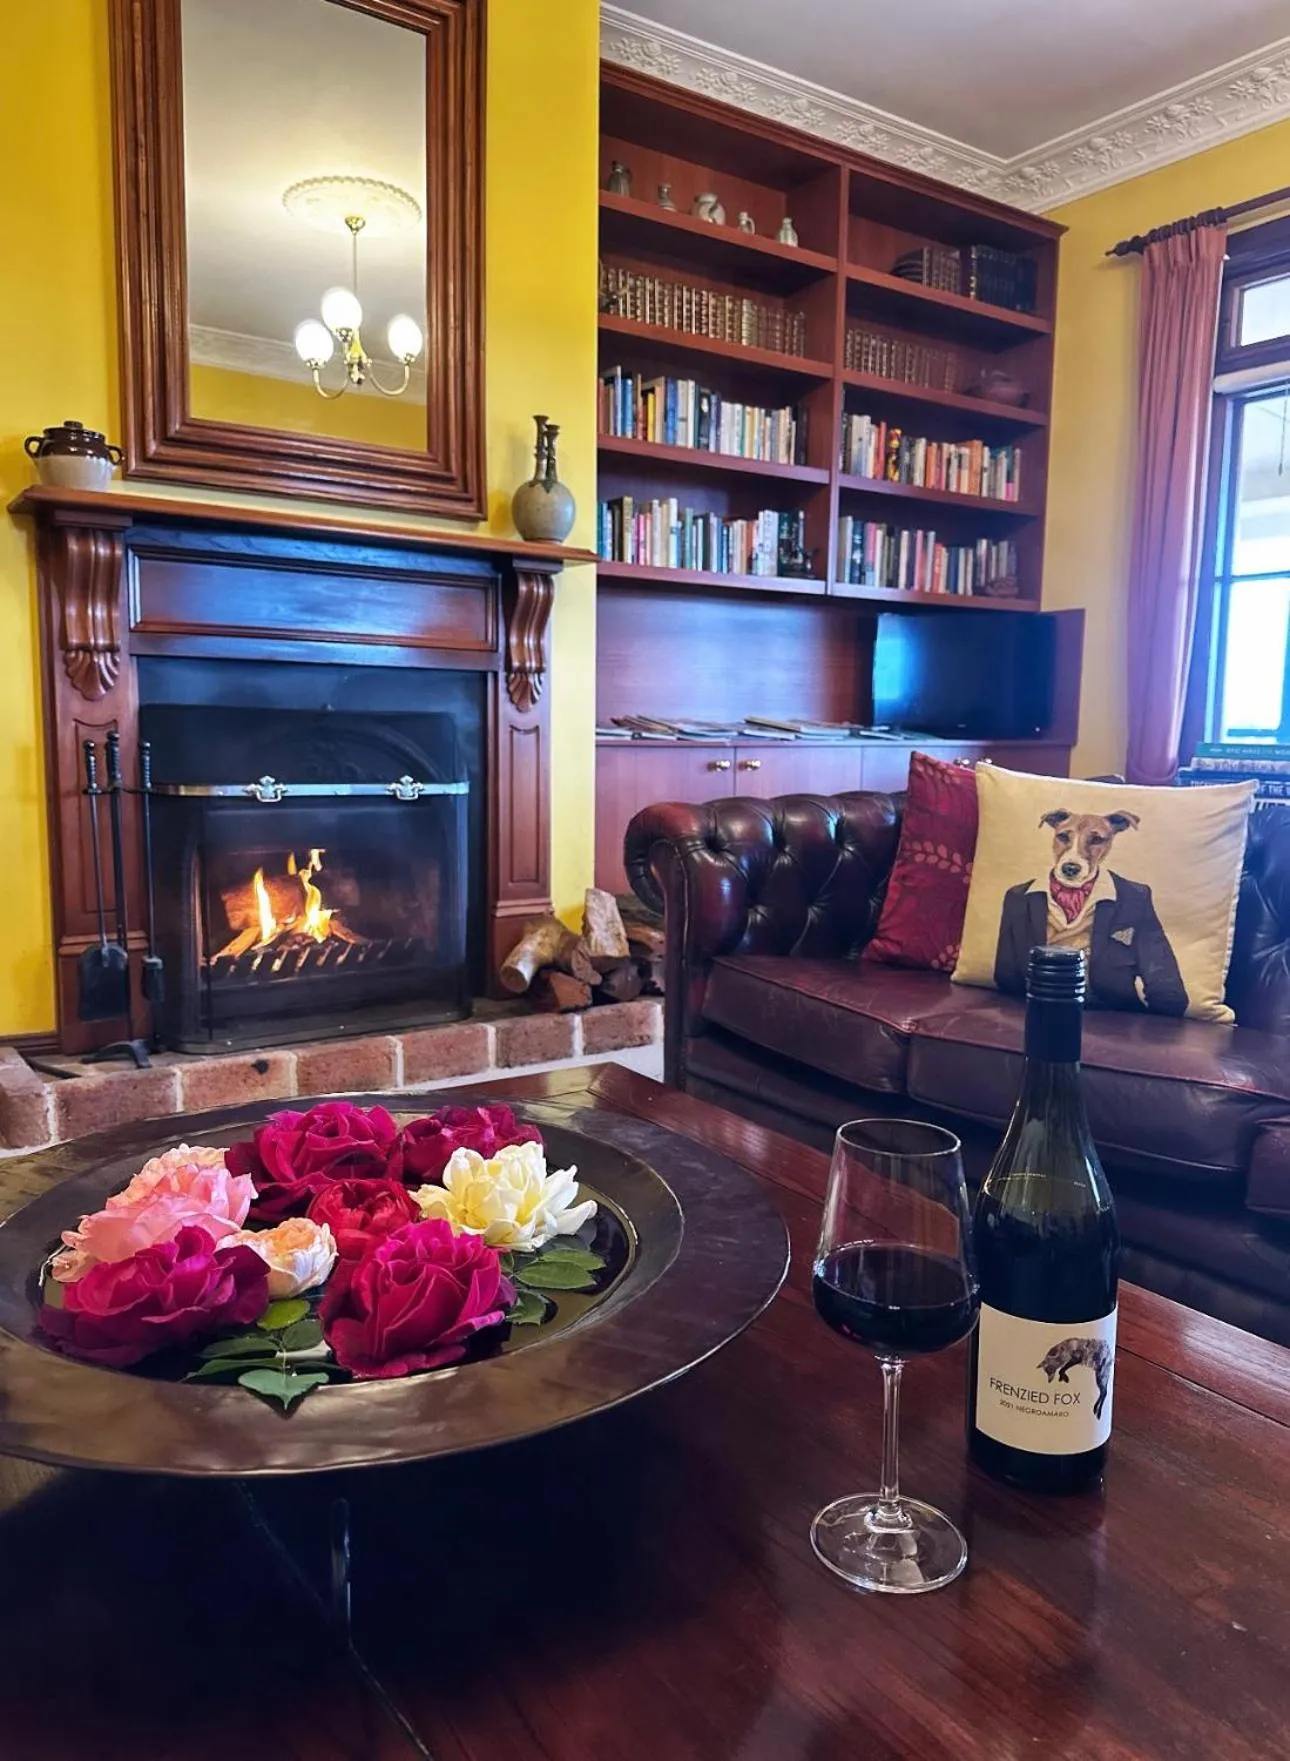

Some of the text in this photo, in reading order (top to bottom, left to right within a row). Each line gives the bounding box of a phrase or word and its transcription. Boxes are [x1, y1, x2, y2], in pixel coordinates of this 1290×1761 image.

[990, 1377, 1081, 1405] FRENZIED FOX
[1016, 1405, 1069, 1418] NEGROAMARO
